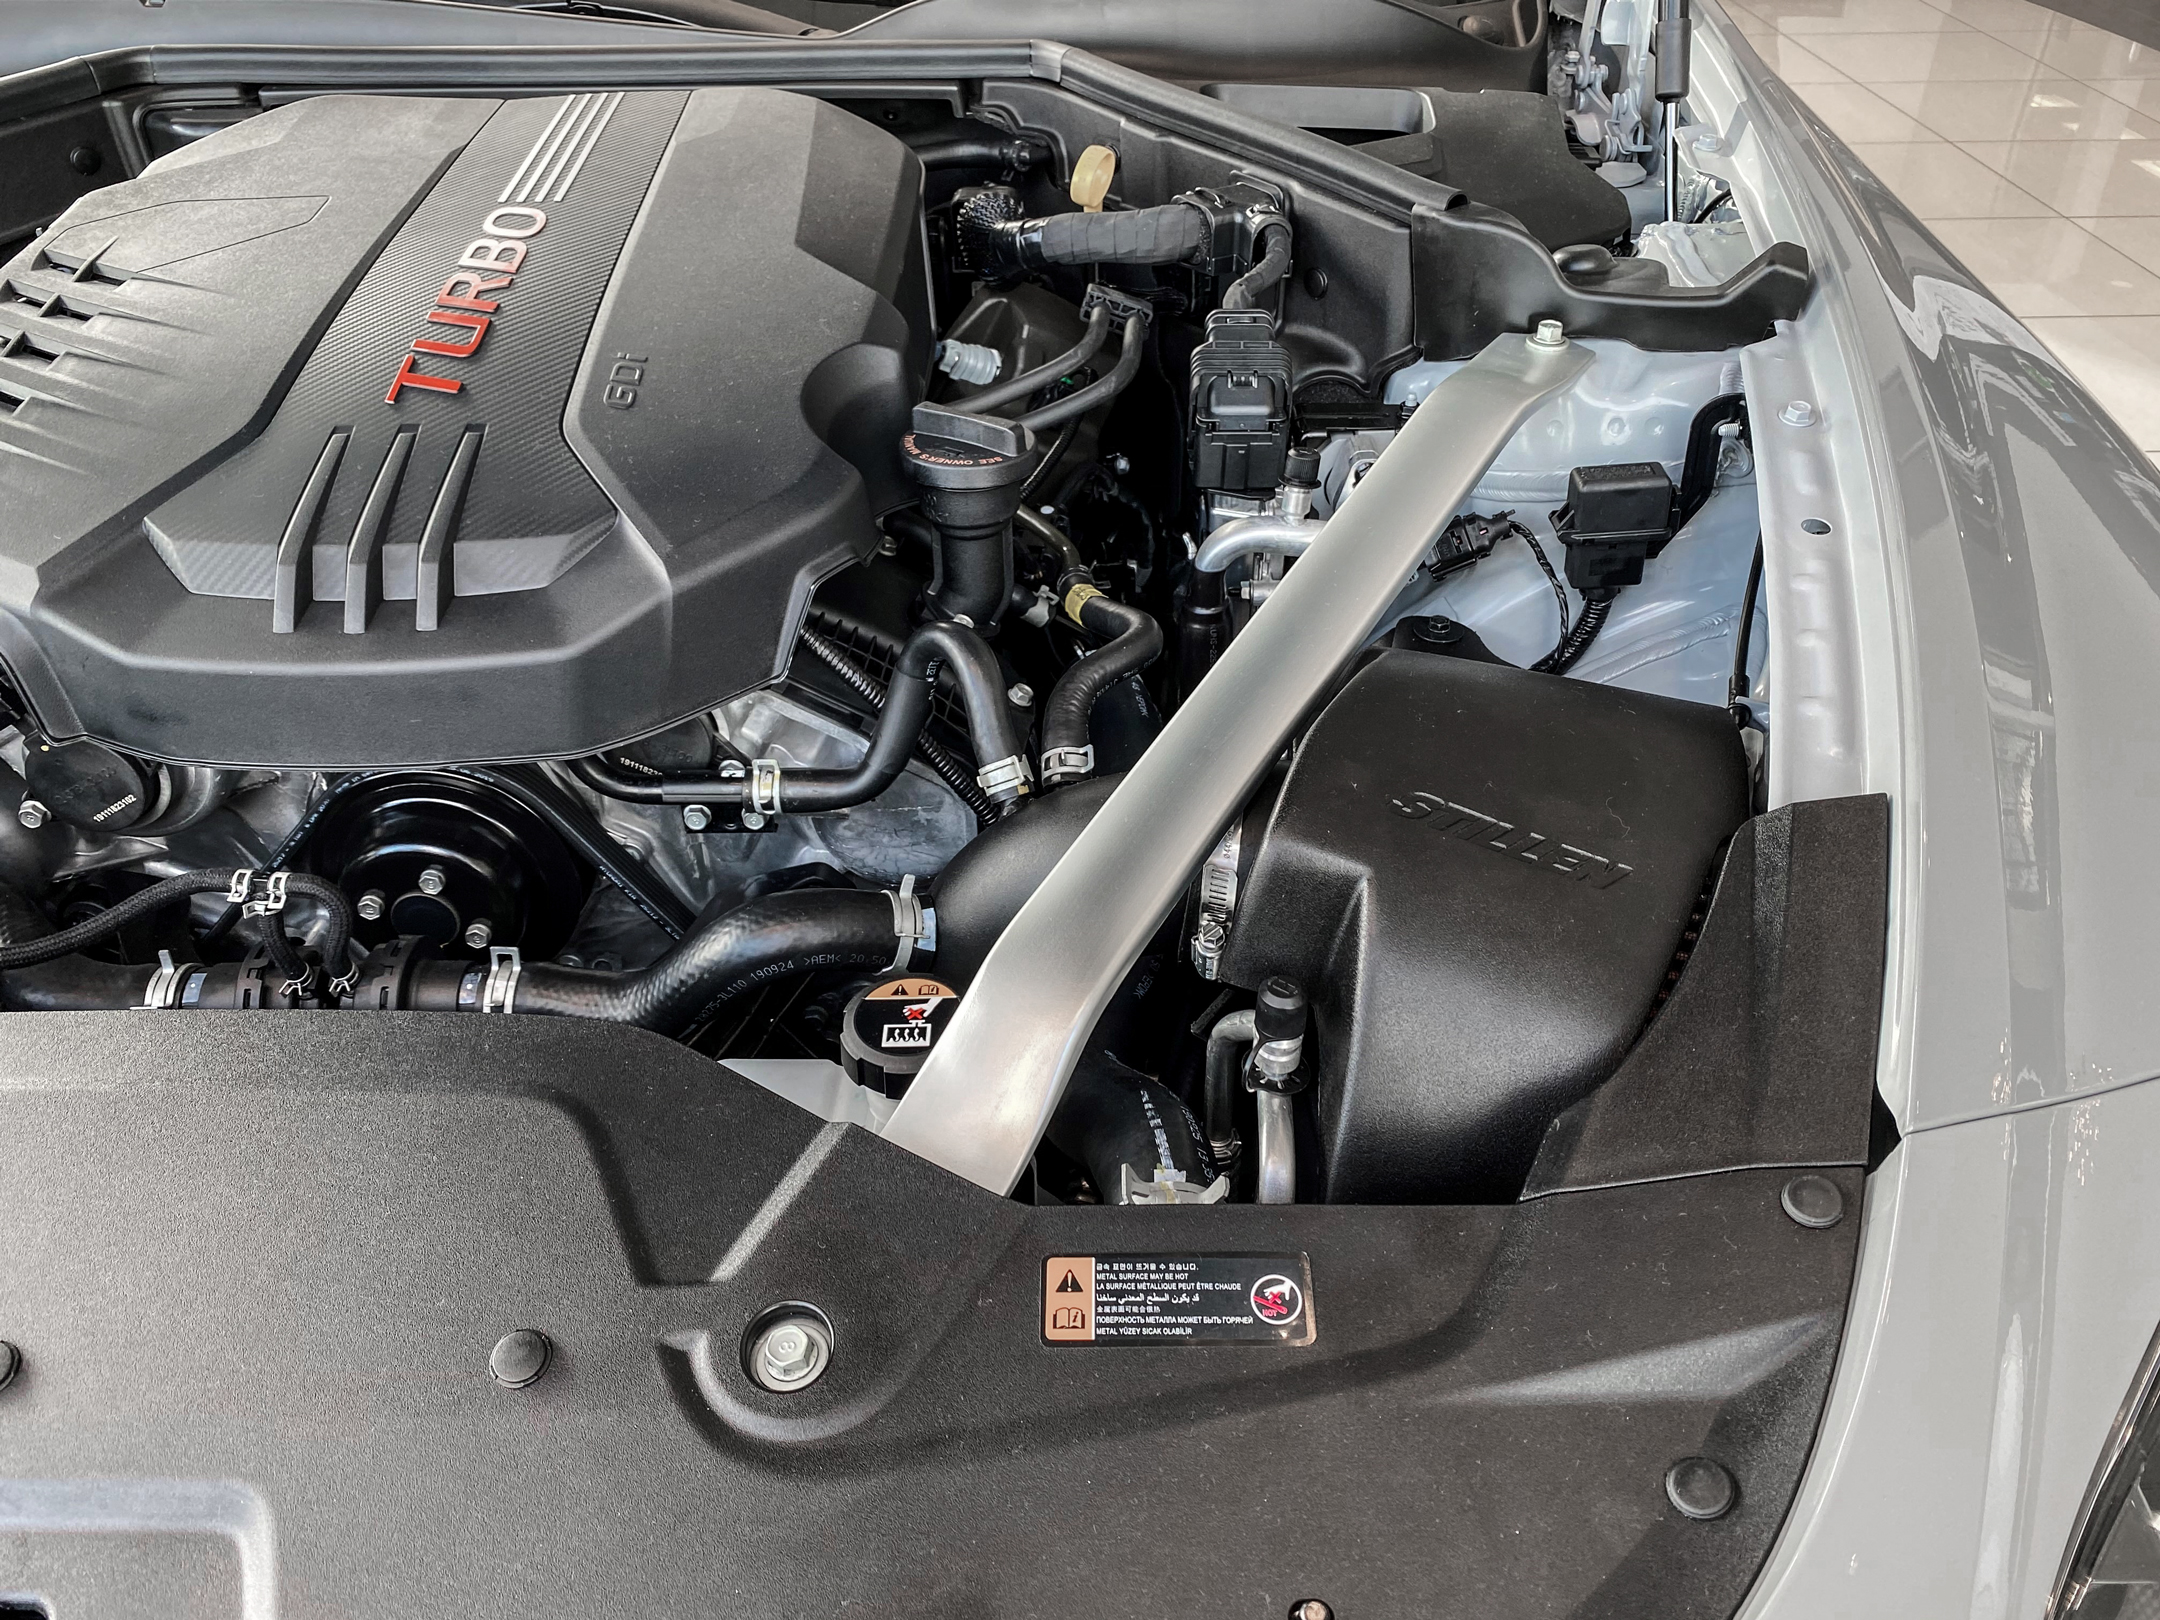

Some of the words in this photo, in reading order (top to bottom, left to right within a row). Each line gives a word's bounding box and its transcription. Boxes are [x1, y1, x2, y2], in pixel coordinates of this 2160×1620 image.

[384, 206, 548, 405] TURBO
[919, 452, 974, 466] OWNER'S
[978, 456, 1003, 465] SEE
[750, 959, 795, 982] 190924
[1096, 1262, 1110, 1271] 금속
[1112, 1262, 1133, 1271] 표면이
[1159, 1262, 1166, 1271] 수
[1096, 1272, 1117, 1280] METAL
[1118, 1272, 1149, 1280] SURFACE
[1149, 1272, 1164, 1280] MAY
[1164, 1272, 1174, 1280] BE
[1175, 1272, 1189, 1280] HOT
[1096, 1282, 1105, 1290] LA
[1105, 1282, 1136, 1290] SURFACE
[1137, 1281, 1177, 1290] MÉTALLIQUE
[1178, 1282, 1195, 1290] PEUT
[1196, 1281, 1214, 1290] ÊTRE
[1214, 1282, 1242, 1290] CHAUDE
[1262, 1308, 1278, 1317] HOT
[1096, 1316, 1145, 1324] ПОВЕРХНОСТЬ
[1177, 1316, 1202, 1324] МОЖЕТ
[1203, 1316, 1222, 1324] БЫТЬ
[1222, 1315, 1254, 1324] ГОРЯЧЕЙ
[1096, 1327, 1118, 1335] METAL
[1119, 1326, 1141, 1335] YÜZEY
[1142, 1327, 1162, 1335] SICAK
